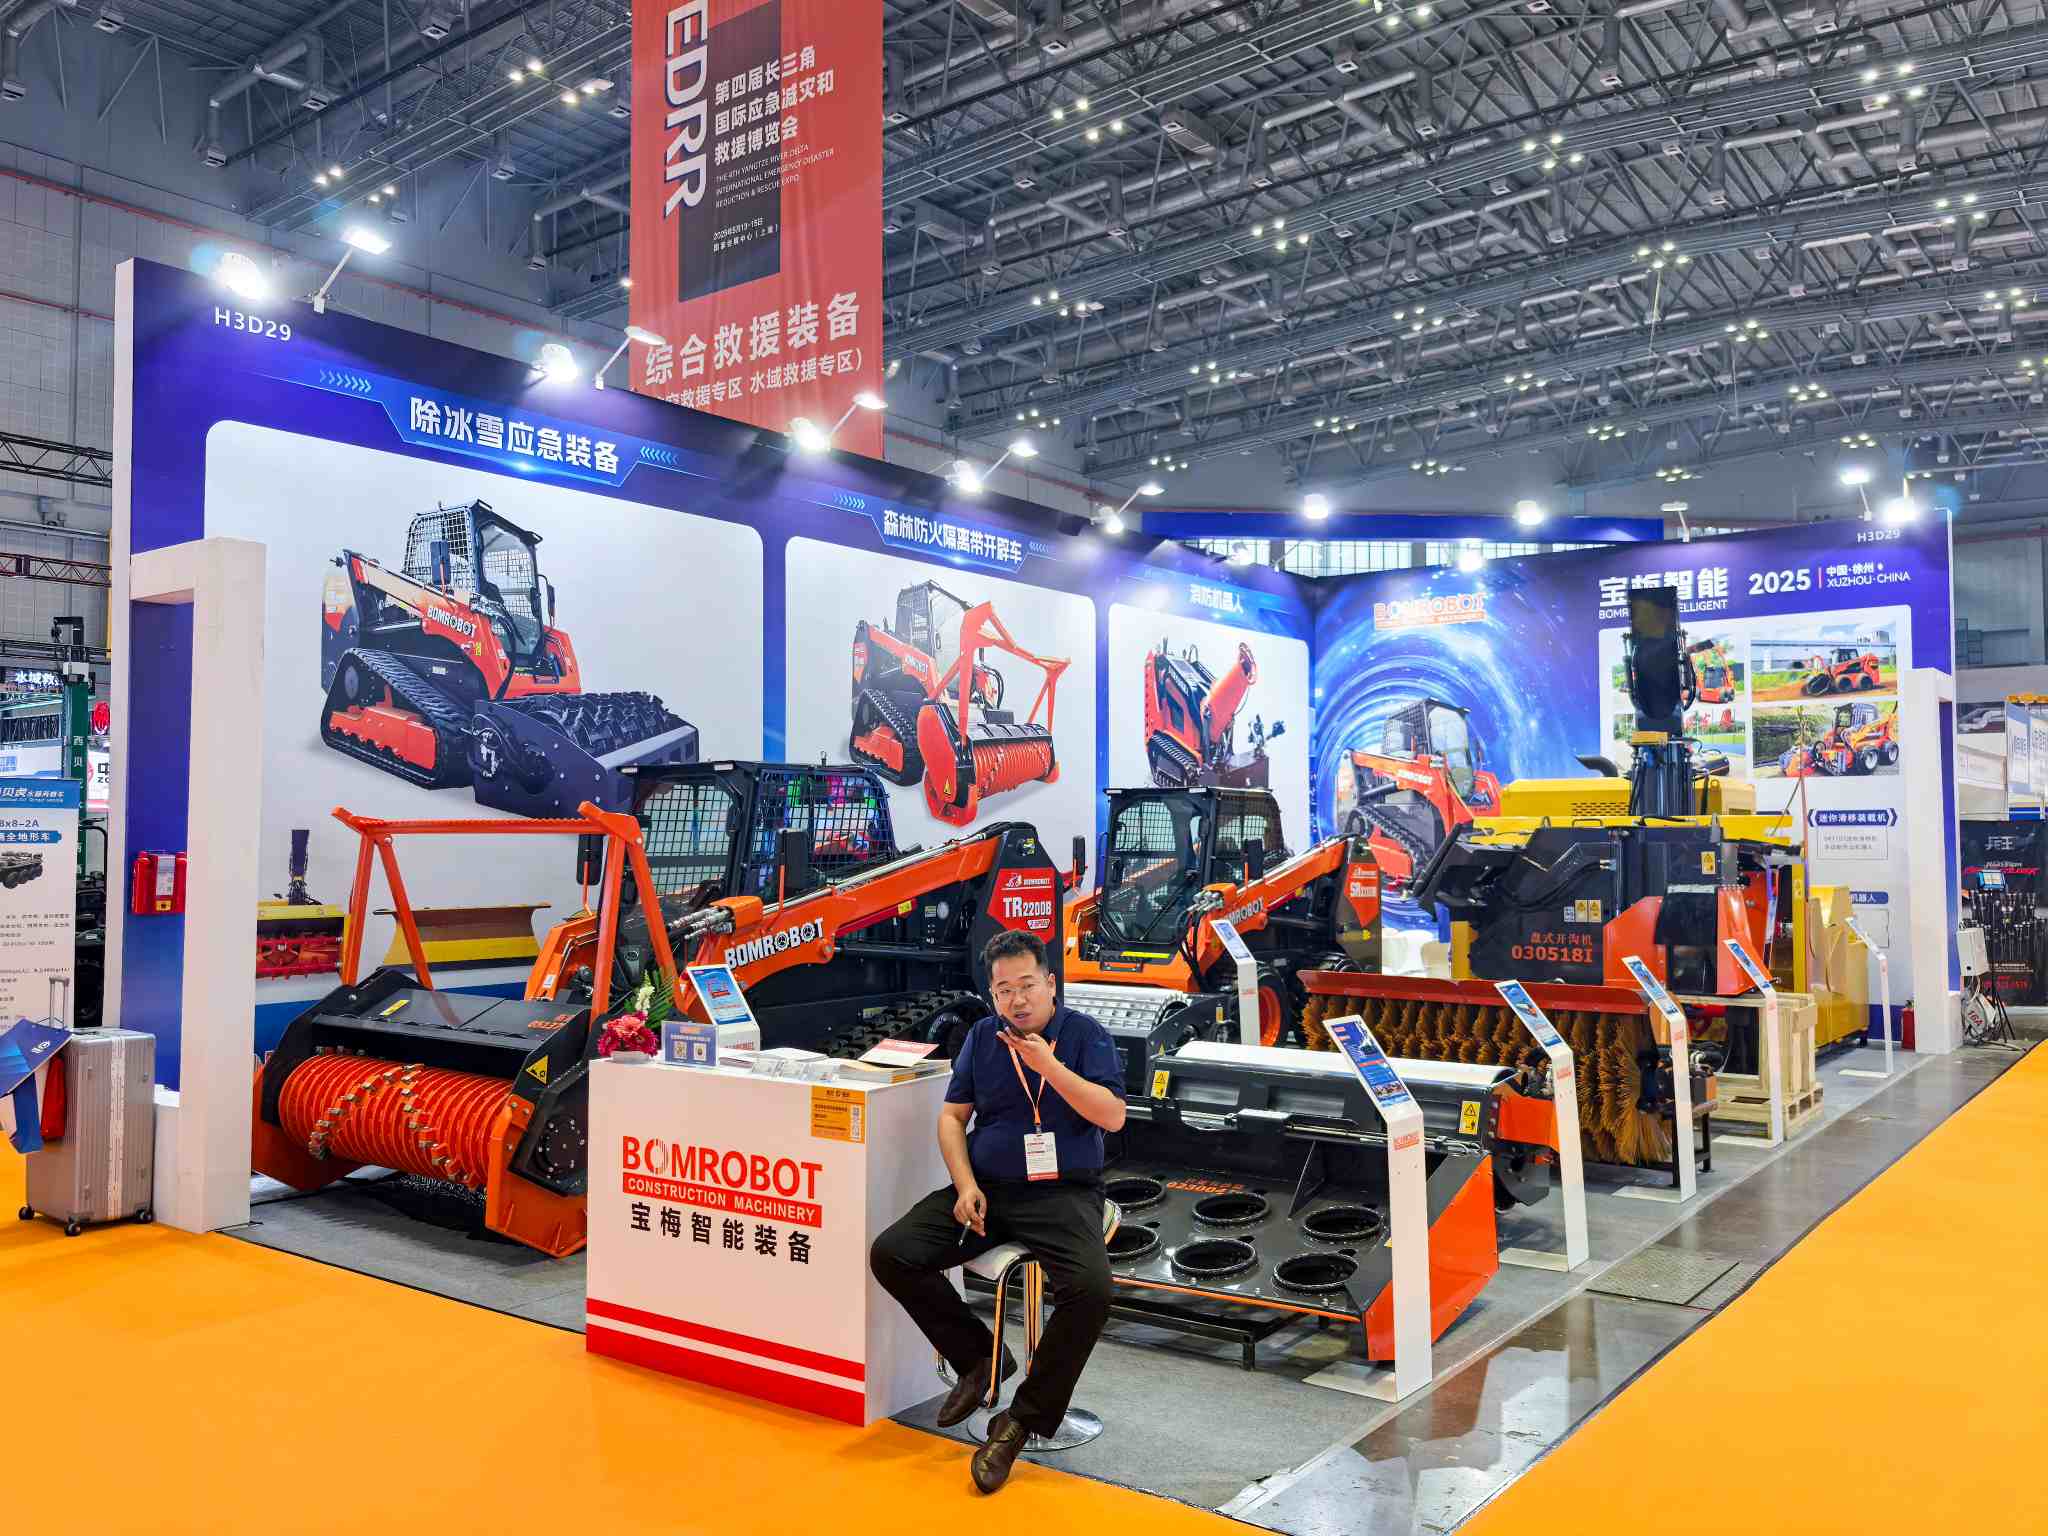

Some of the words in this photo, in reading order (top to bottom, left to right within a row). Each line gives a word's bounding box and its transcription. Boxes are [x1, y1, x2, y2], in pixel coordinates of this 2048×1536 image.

[715, 45, 816, 106] 第四届长三角
[715, 69, 835, 136] 国际应急减灾和
[715, 116, 798, 167] 救援博览会
[214, 306, 292, 342] H3D29
[645, 292, 860, 386] 综合救援装备
[410, 397, 619, 475] 除冰雪应急装备
[882, 509, 1023, 565] 森林防火隔离带开辟车
[1856, 529, 1901, 543] H3D29
[1748, 568, 1811, 595] 2025
[427, 606, 477, 639] BOMROBOT
[725, 918, 823, 970] BOMROBOT
[622, 1135, 823, 1199] BOMROBOT
[627, 1177, 726, 1206] CONSTRUCTION
[734, 1196, 816, 1223] MACHINERY
[631, 1201, 812, 1264] 宝梅智能装备
